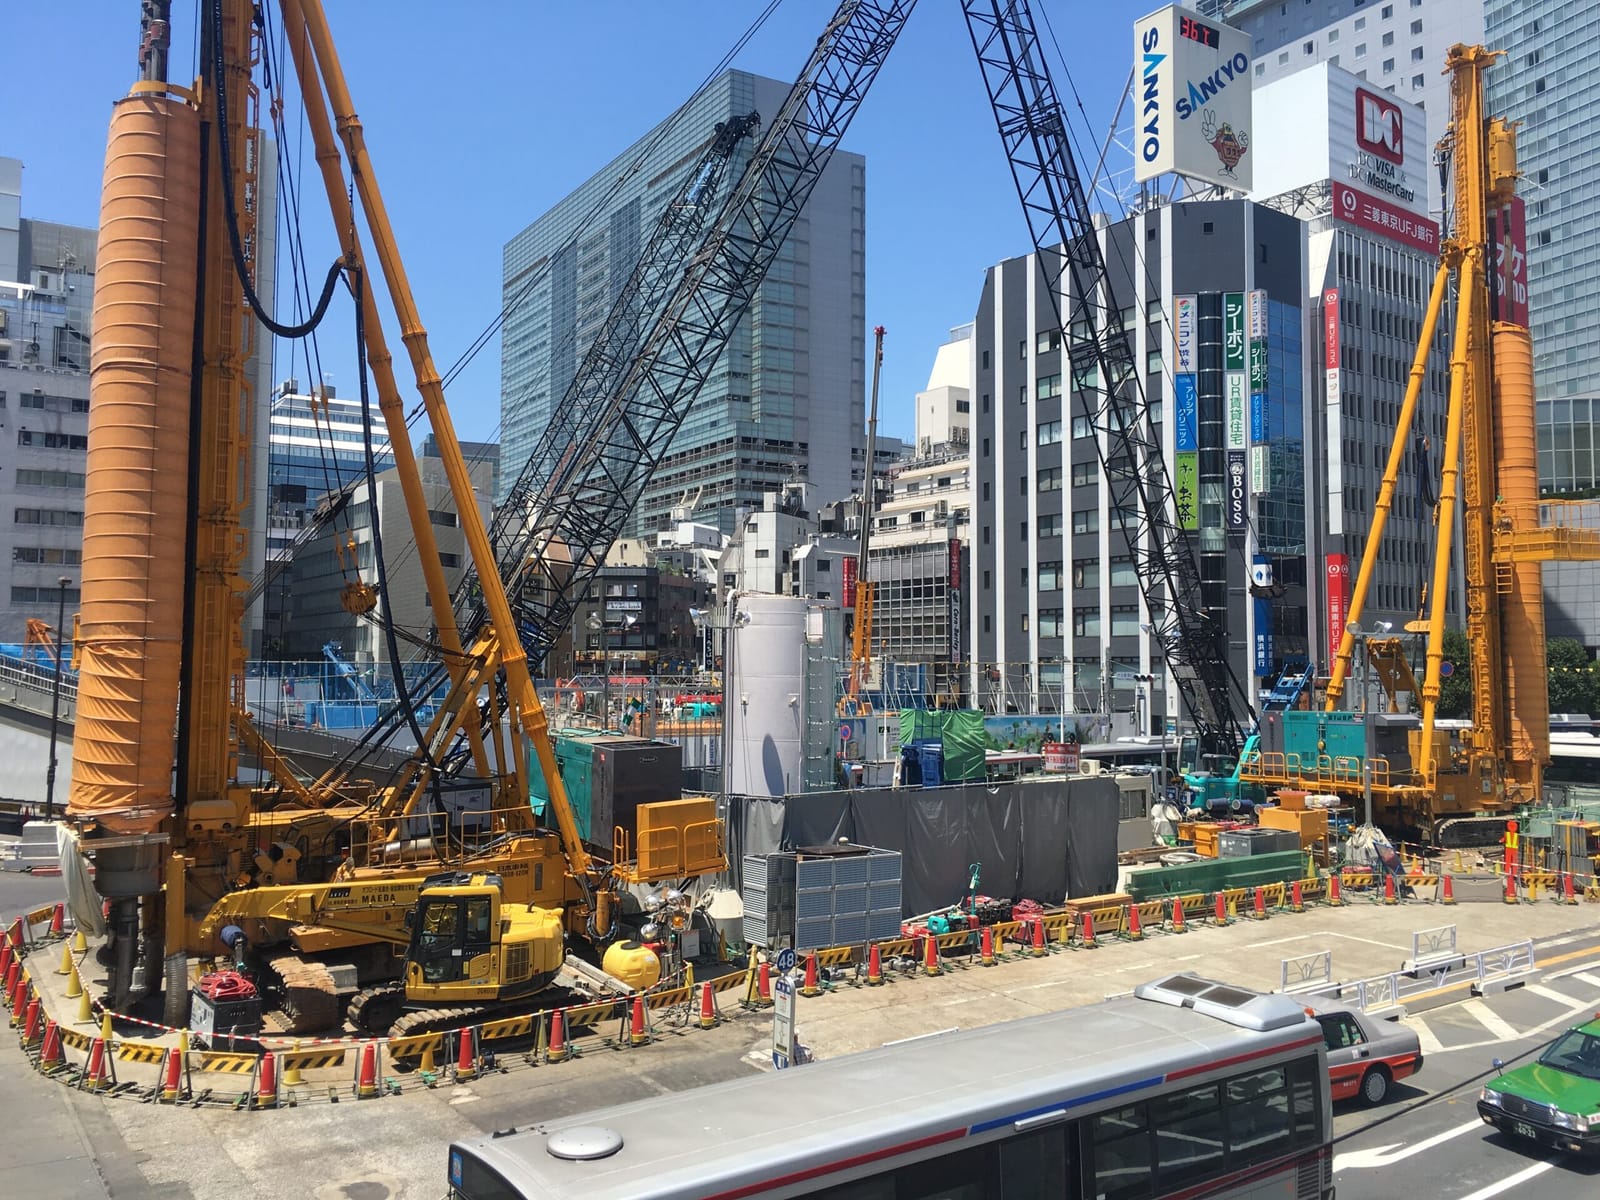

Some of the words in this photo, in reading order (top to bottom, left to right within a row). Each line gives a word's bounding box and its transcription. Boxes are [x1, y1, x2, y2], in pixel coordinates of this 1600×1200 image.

[1143, 27, 1167, 162] SANKYO
[1175, 52, 1248, 120] SANKYO
[1366, 170, 1415, 203] MasterCard
[1375, 160, 1396, 179] VISA
[1362, 203, 1434, 245] 三菱東京UFJ銀行
[1185, 386, 1194, 416] アリシア
[1230, 375, 1243, 445] UR賃貸住宅
[1231, 475, 1243, 525] BOSS
[362, 894, 396, 903] MAEDA
[779, 953, 794, 968] 48
